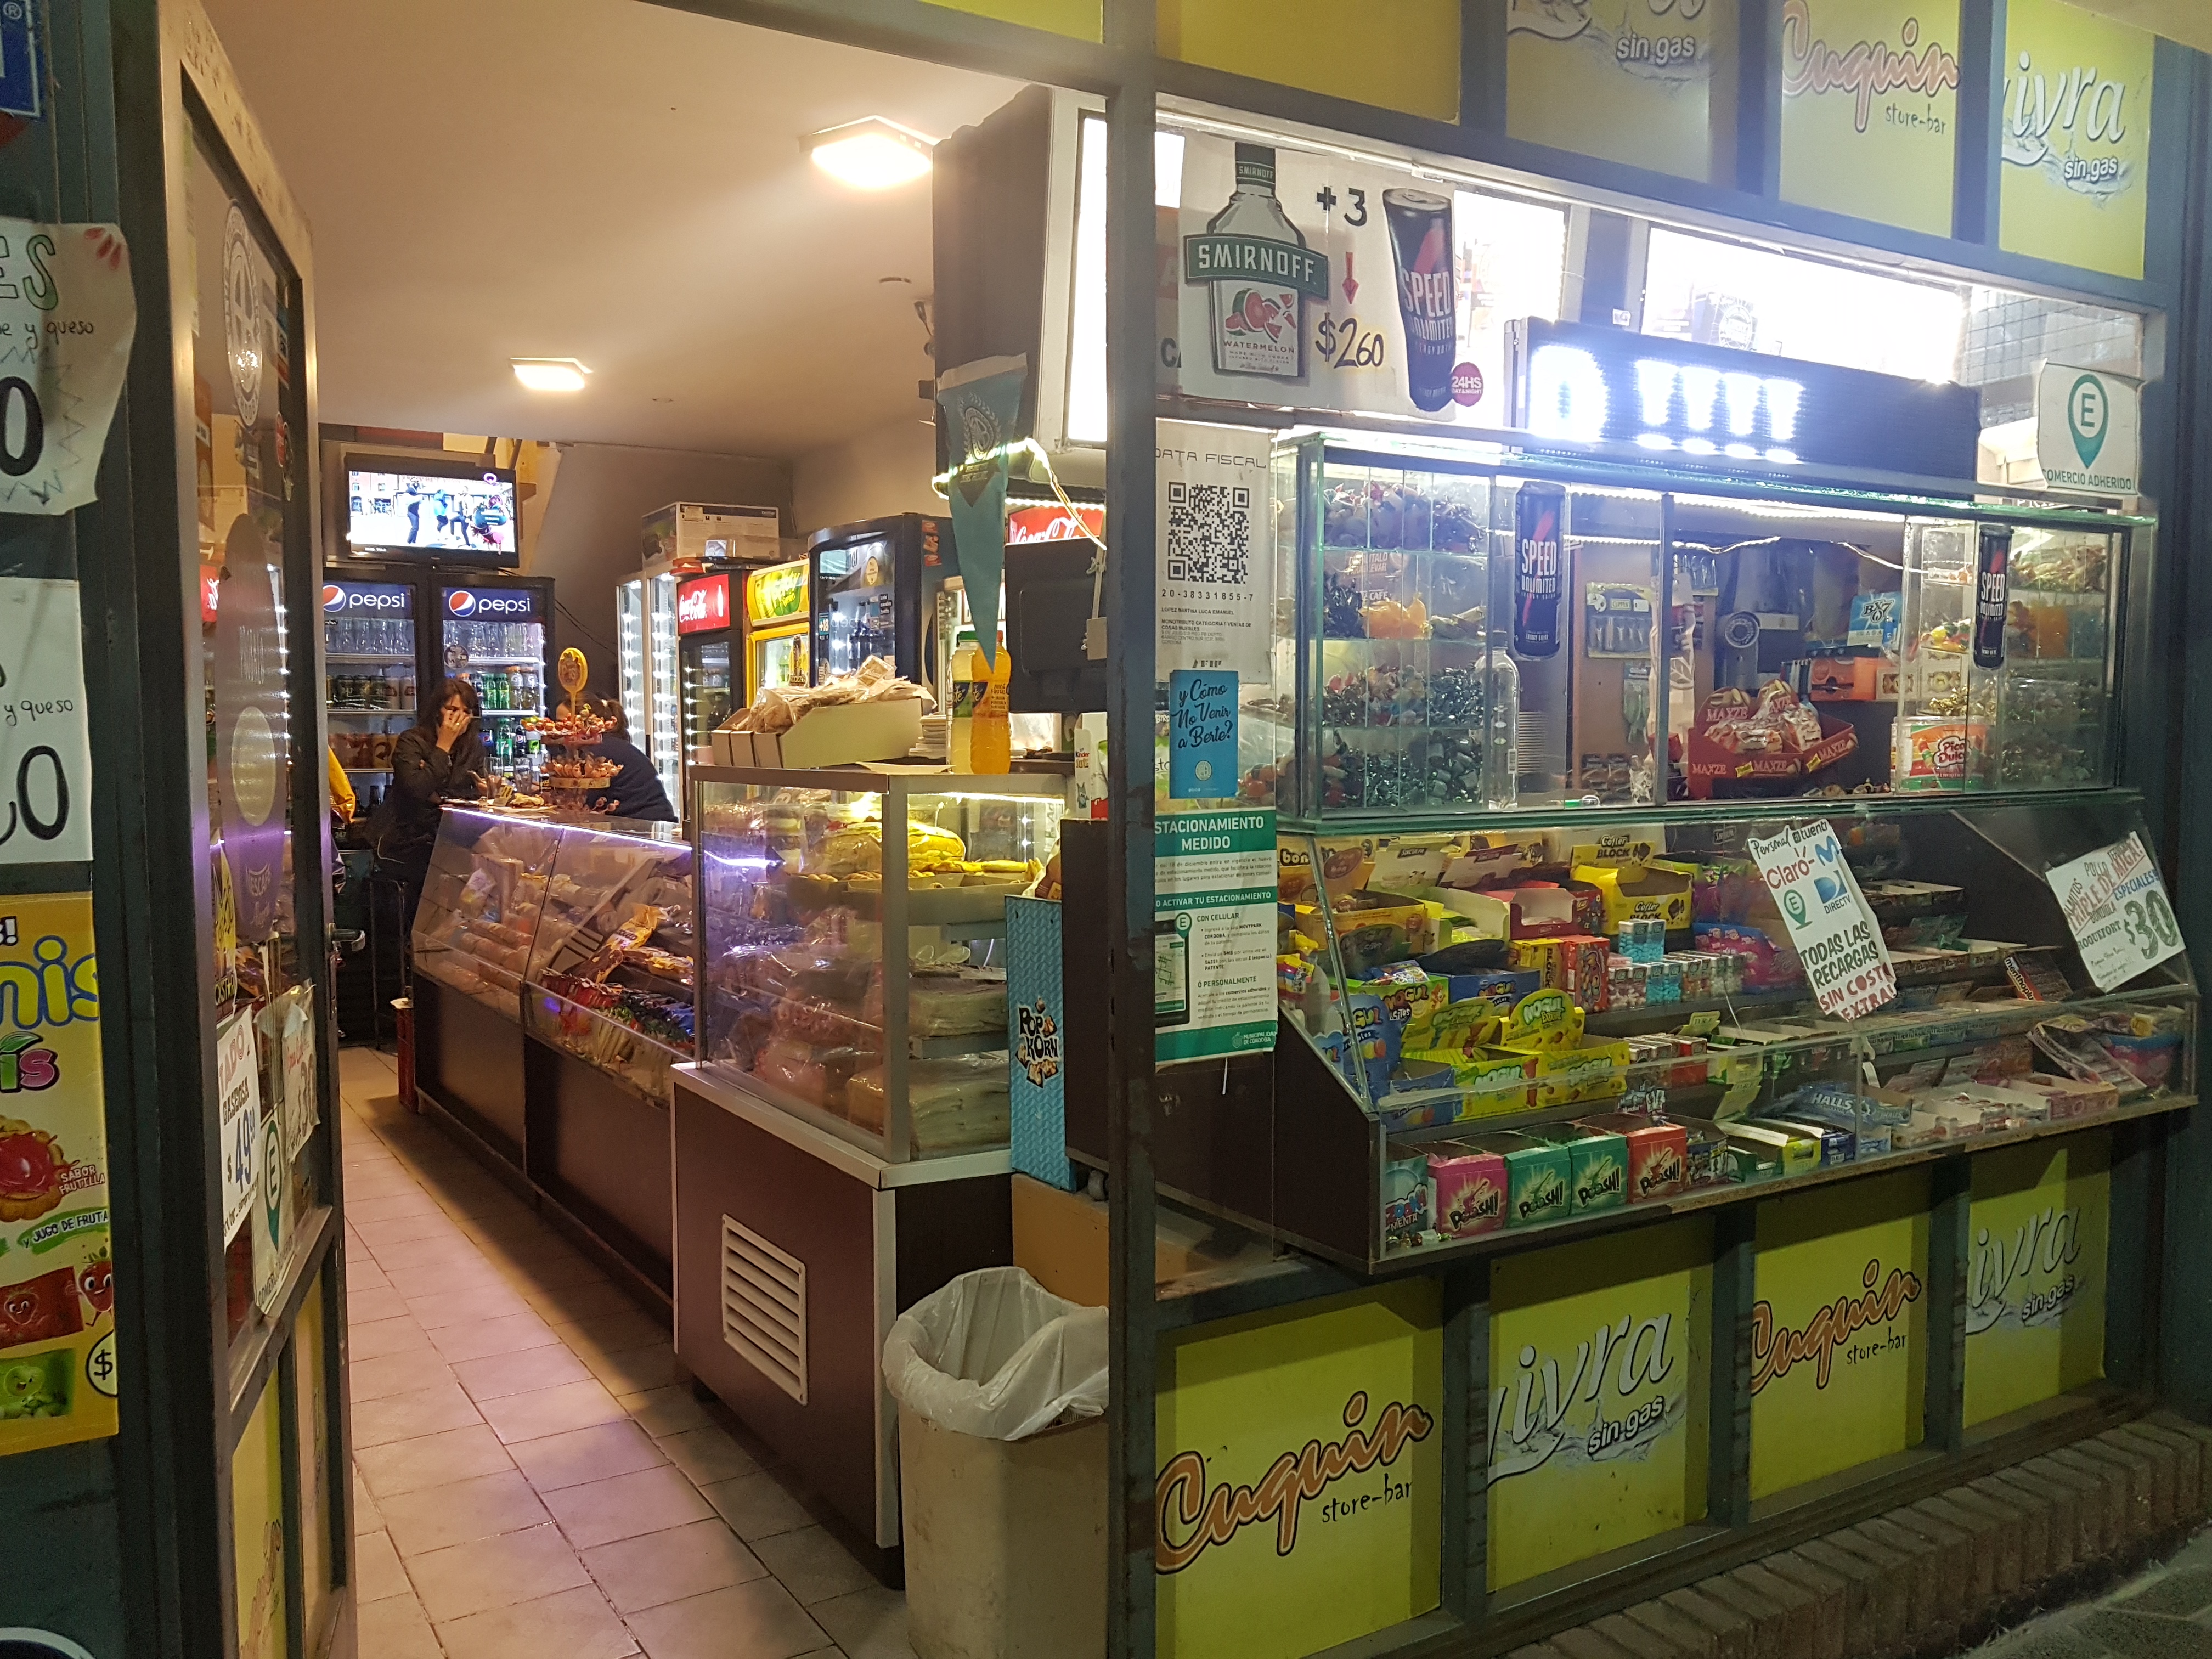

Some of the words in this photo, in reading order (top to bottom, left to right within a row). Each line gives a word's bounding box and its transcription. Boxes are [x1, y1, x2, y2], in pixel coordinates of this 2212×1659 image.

[1617, 32, 1650, 59] sin
[1655, 35, 1696, 65] gas
[2003, 51, 2126, 151] ivra
[1885, 103, 1947, 136] store-bar
[1238, 165, 1274, 179] SMIRNOFF
[2064, 156, 2087, 180] sin
[2090, 155, 2118, 184] gas
[1344, 187, 1368, 227] 3
[1198, 243, 1316, 283] SMIRNOFF
[1402, 268, 1452, 319] SPEED
[46, 320, 95, 345] queso
[1315, 312, 1384, 369] $260
[1223, 340, 1295, 354] WATERMELON
[1451, 376, 1481, 389] 24HS
[2081, 393, 2096, 427] E
[1205, 453, 1267, 469] FISCAL
[2088, 475, 2132, 490] ADHERIDO
[1521, 538, 1558, 577] SPEED
[1980, 571, 2005, 602] SPEED
[349, 592, 405, 610] pepsi
[478, 597, 531, 614] pepsi
[1190, 678, 1228, 702] Cómo
[20, 699, 74, 721] queso
[1194, 702, 1231, 722] Venir
[1938, 751, 1966, 763] Dulc
[1154, 816, 1265, 834] STACIONAMIENTO
[1181, 835, 1231, 852] MEDIDO
[1596, 848, 1630, 858] BLOCK
[1601, 834, 1628, 848] Cofler
[1750, 825, 1791, 860] Personal
[1801, 821, 1829, 841] tuenti
[1282, 848, 1309, 864] bon
[1765, 859, 1810, 890] Claro
[1162, 898, 1193, 907] ACTIVAR
[1195, 896, 1205, 905] TU
[1206, 891, 1272, 904] ESTACIONAMIENTO
[1634, 902, 1660, 913] Cofler
[1824, 894, 1852, 915] DIRECTV
[2063, 878, 2084, 918] ALMITOS
[1210, 912, 1239, 921] CELULAR
[1800, 933, 1845, 970] TODAS
[1843, 919, 1871, 947] LAS
[2076, 920, 2123, 950] ROQUEFORT
[1812, 940, 1880, 989] RECARGAS
[1203, 975, 1257, 988] PERSONALMENTE
[2004, 957, 2035, 1001] menthoplu
[1383, 984, 1430, 1011] MOGUL
[1523, 995, 1566, 1025] MOGUL
[1820, 987, 1846, 1012] SIN
[1018, 1006, 1044, 1037] POP
[1352, 1006, 1384, 1029] GUL
[1025, 1035, 1059, 1062] KORN
[1810, 1092, 1853, 1110] HALLS
[58, 1173, 106, 1197] FRUTILLA
[60, 1164, 97, 1183] SABOR
[33, 1223, 59, 1242] JUGO
[61, 1218, 75, 1232] DE
[1390, 1214, 1419, 1231] MENTA
[1966, 1206, 2081, 1325] ivra
[2021, 1294, 2045, 1322] sin
[2046, 1273, 2075, 1305] gas
[1847, 1327, 1907, 1364] store-bar
[94, 1350, 113, 1381] $
[1587, 1419, 1620, 1455] sin
[1624, 1395, 1664, 1440] gas
[1155, 1391, 1434, 1575] Cuquin
[1321, 1473, 1413, 1523] store-bar
